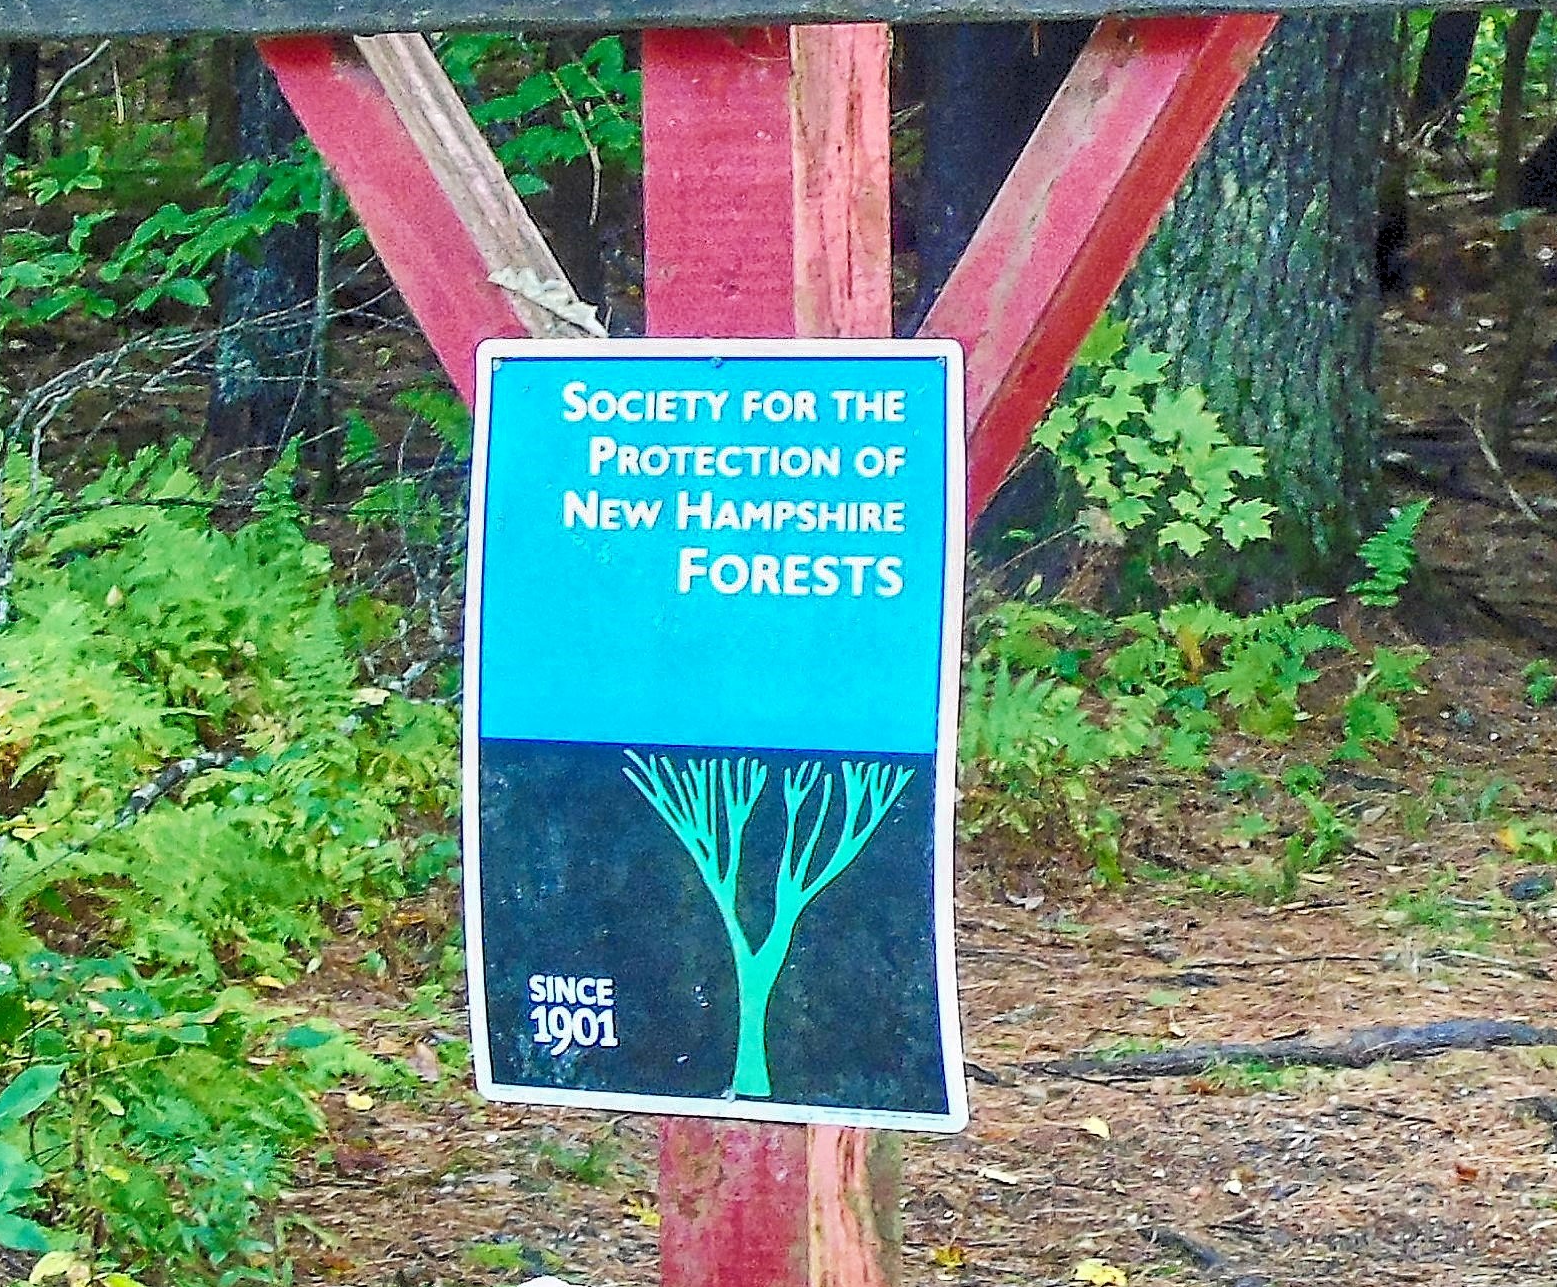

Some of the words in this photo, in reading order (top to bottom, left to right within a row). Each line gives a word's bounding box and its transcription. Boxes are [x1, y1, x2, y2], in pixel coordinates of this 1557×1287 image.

[562, 380, 729, 423] SOCIETY
[743, 389, 818, 423] FOR
[831, 389, 906, 423] THE
[589, 435, 841, 477] PROTECTION
[854, 445, 906, 478] OF
[562, 489, 663, 531] NEW
[676, 490, 906, 532] HAMPSHIRE
[677, 547, 904, 597] FORESTS
[528, 974, 615, 1006] SINCE
[529, 1005, 619, 1056] 1901
